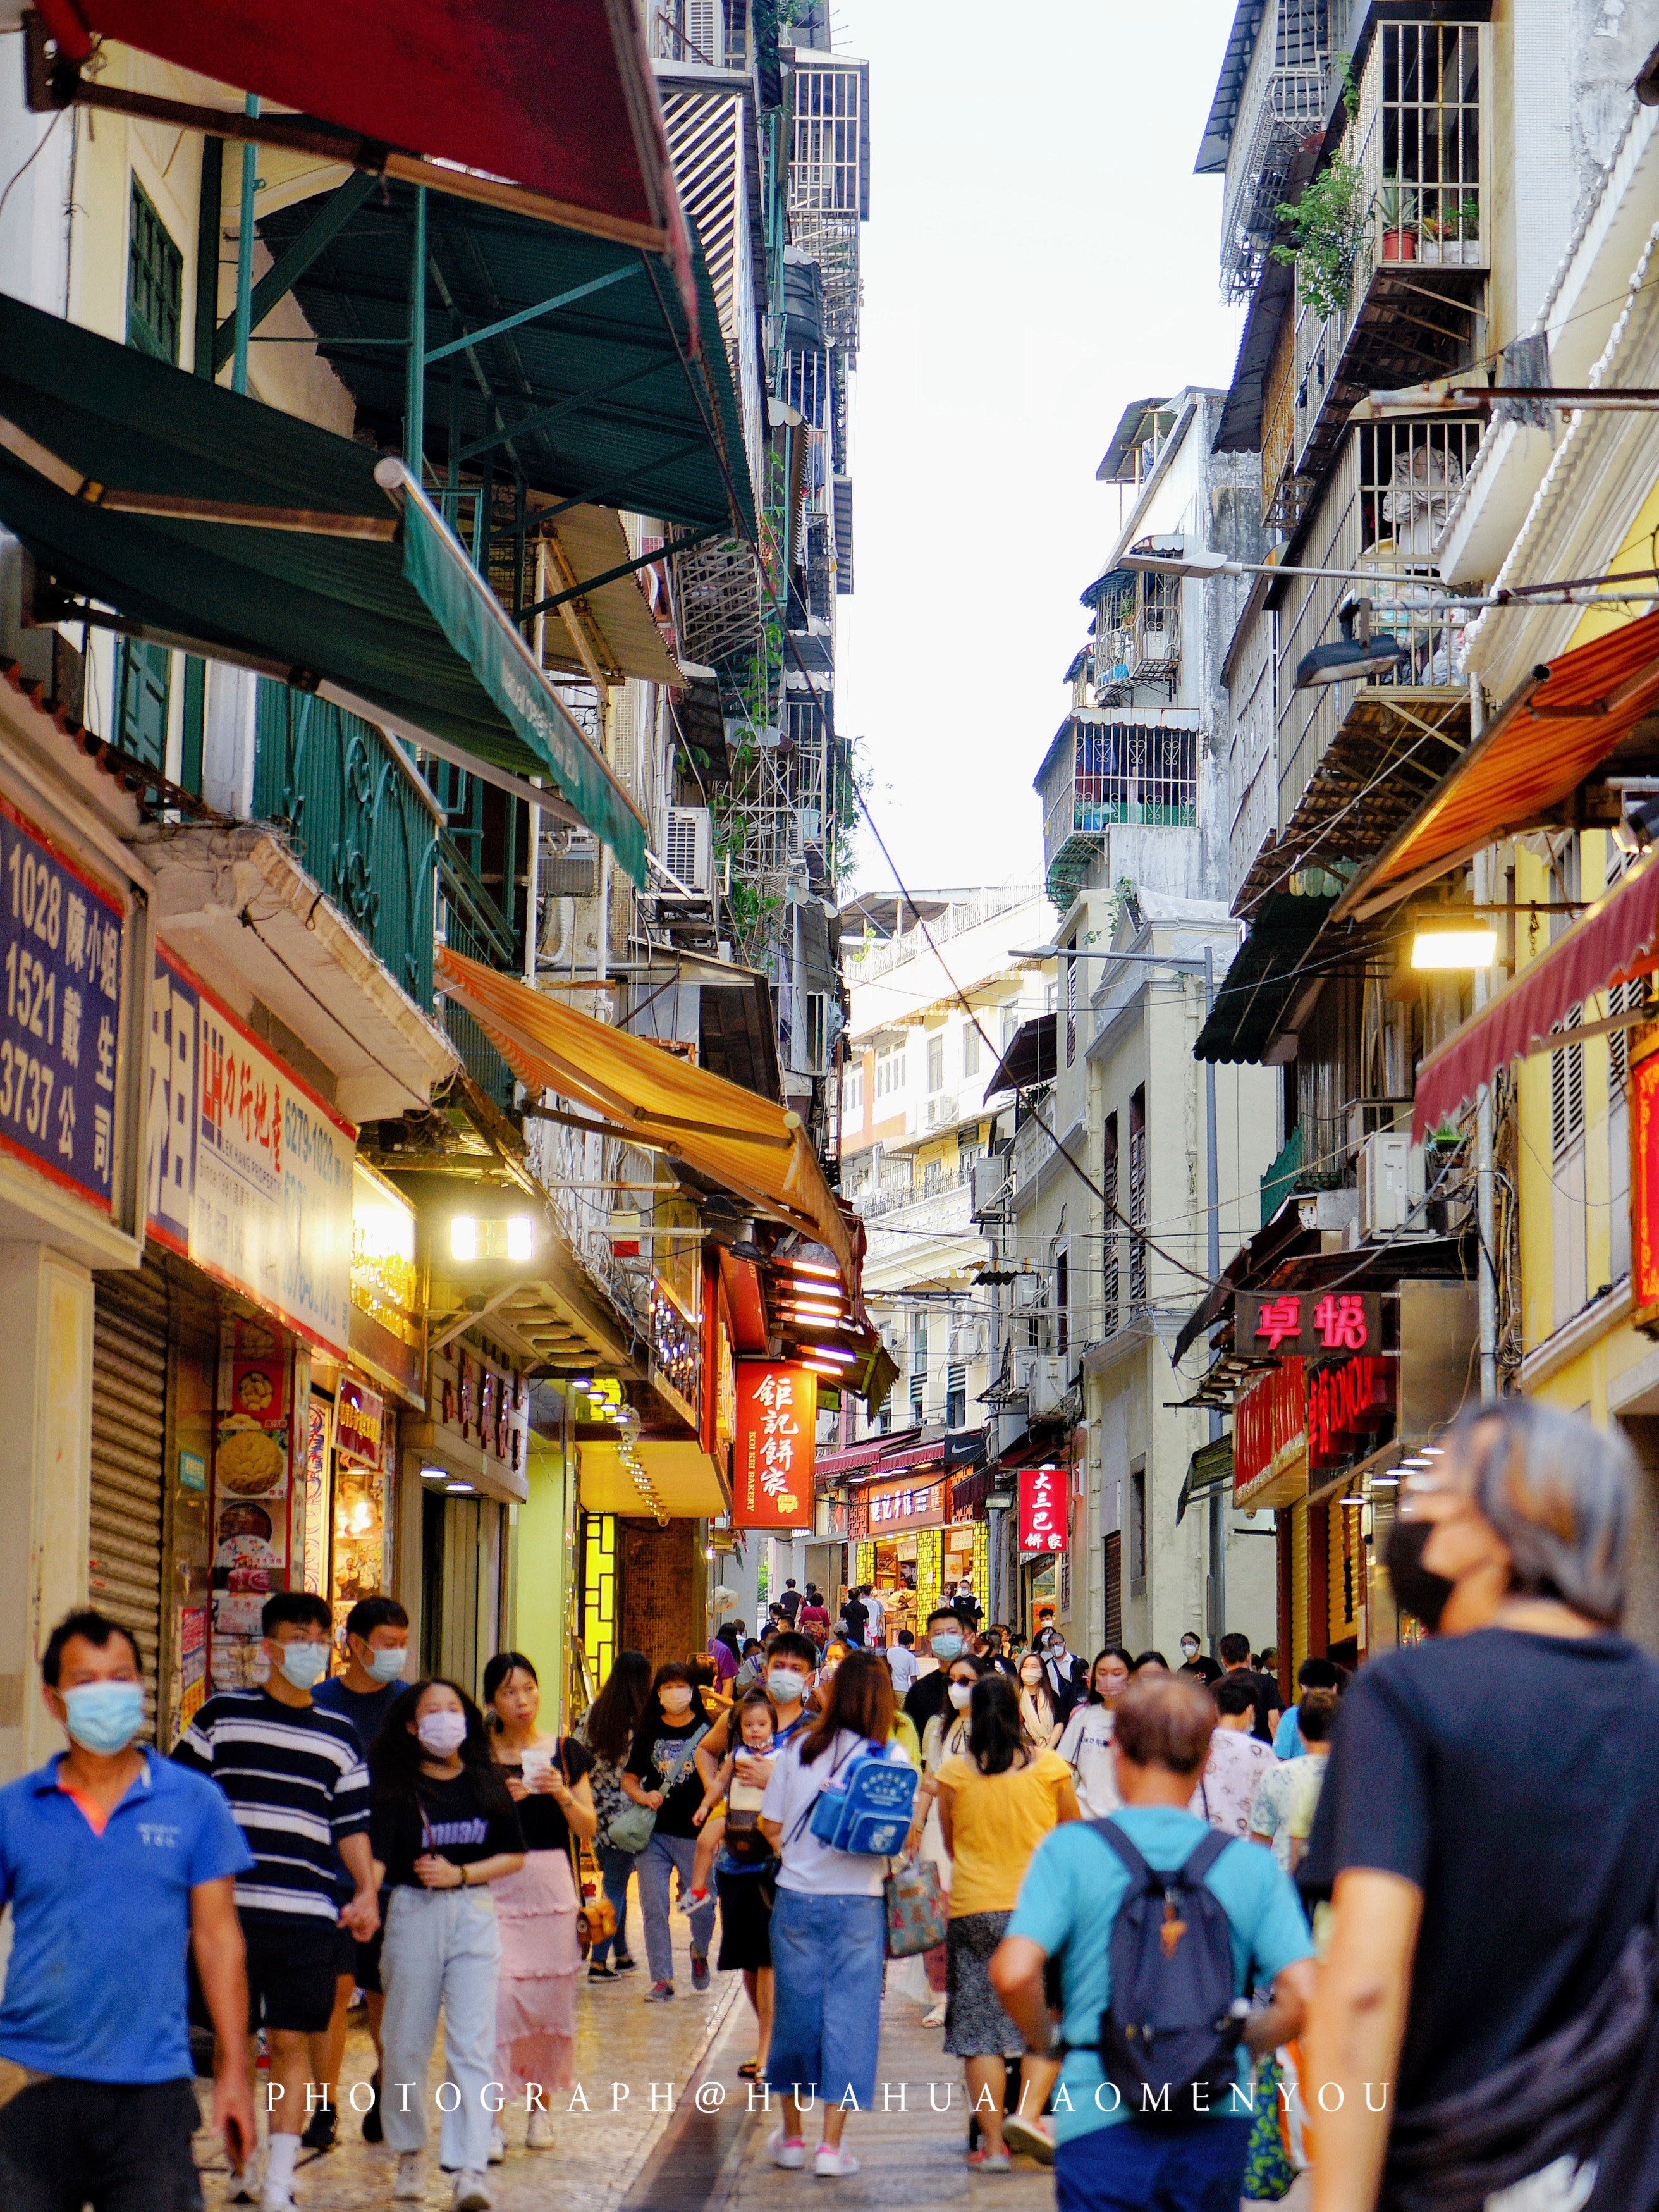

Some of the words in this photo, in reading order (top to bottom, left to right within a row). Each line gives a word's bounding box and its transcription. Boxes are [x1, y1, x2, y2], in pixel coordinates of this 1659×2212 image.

[8, 843, 61, 950] 1028
[64, 892, 118, 1002] 陳小姐
[5, 941, 55, 1045] 1521
[0, 1038, 54, 1140] 3737
[58, 1085, 111, 1185] 公司
[224, 1050, 281, 1174] 力行地產
[252, 1159, 281, 1198] PROPERTY
[1256, 1294, 1368, 1351] 卓悅
[752, 1374, 799, 1497] 鉅記餅家
[747, 1471, 756, 1512] BAKERY
[1031, 1472, 1053, 1530] 大三巴
